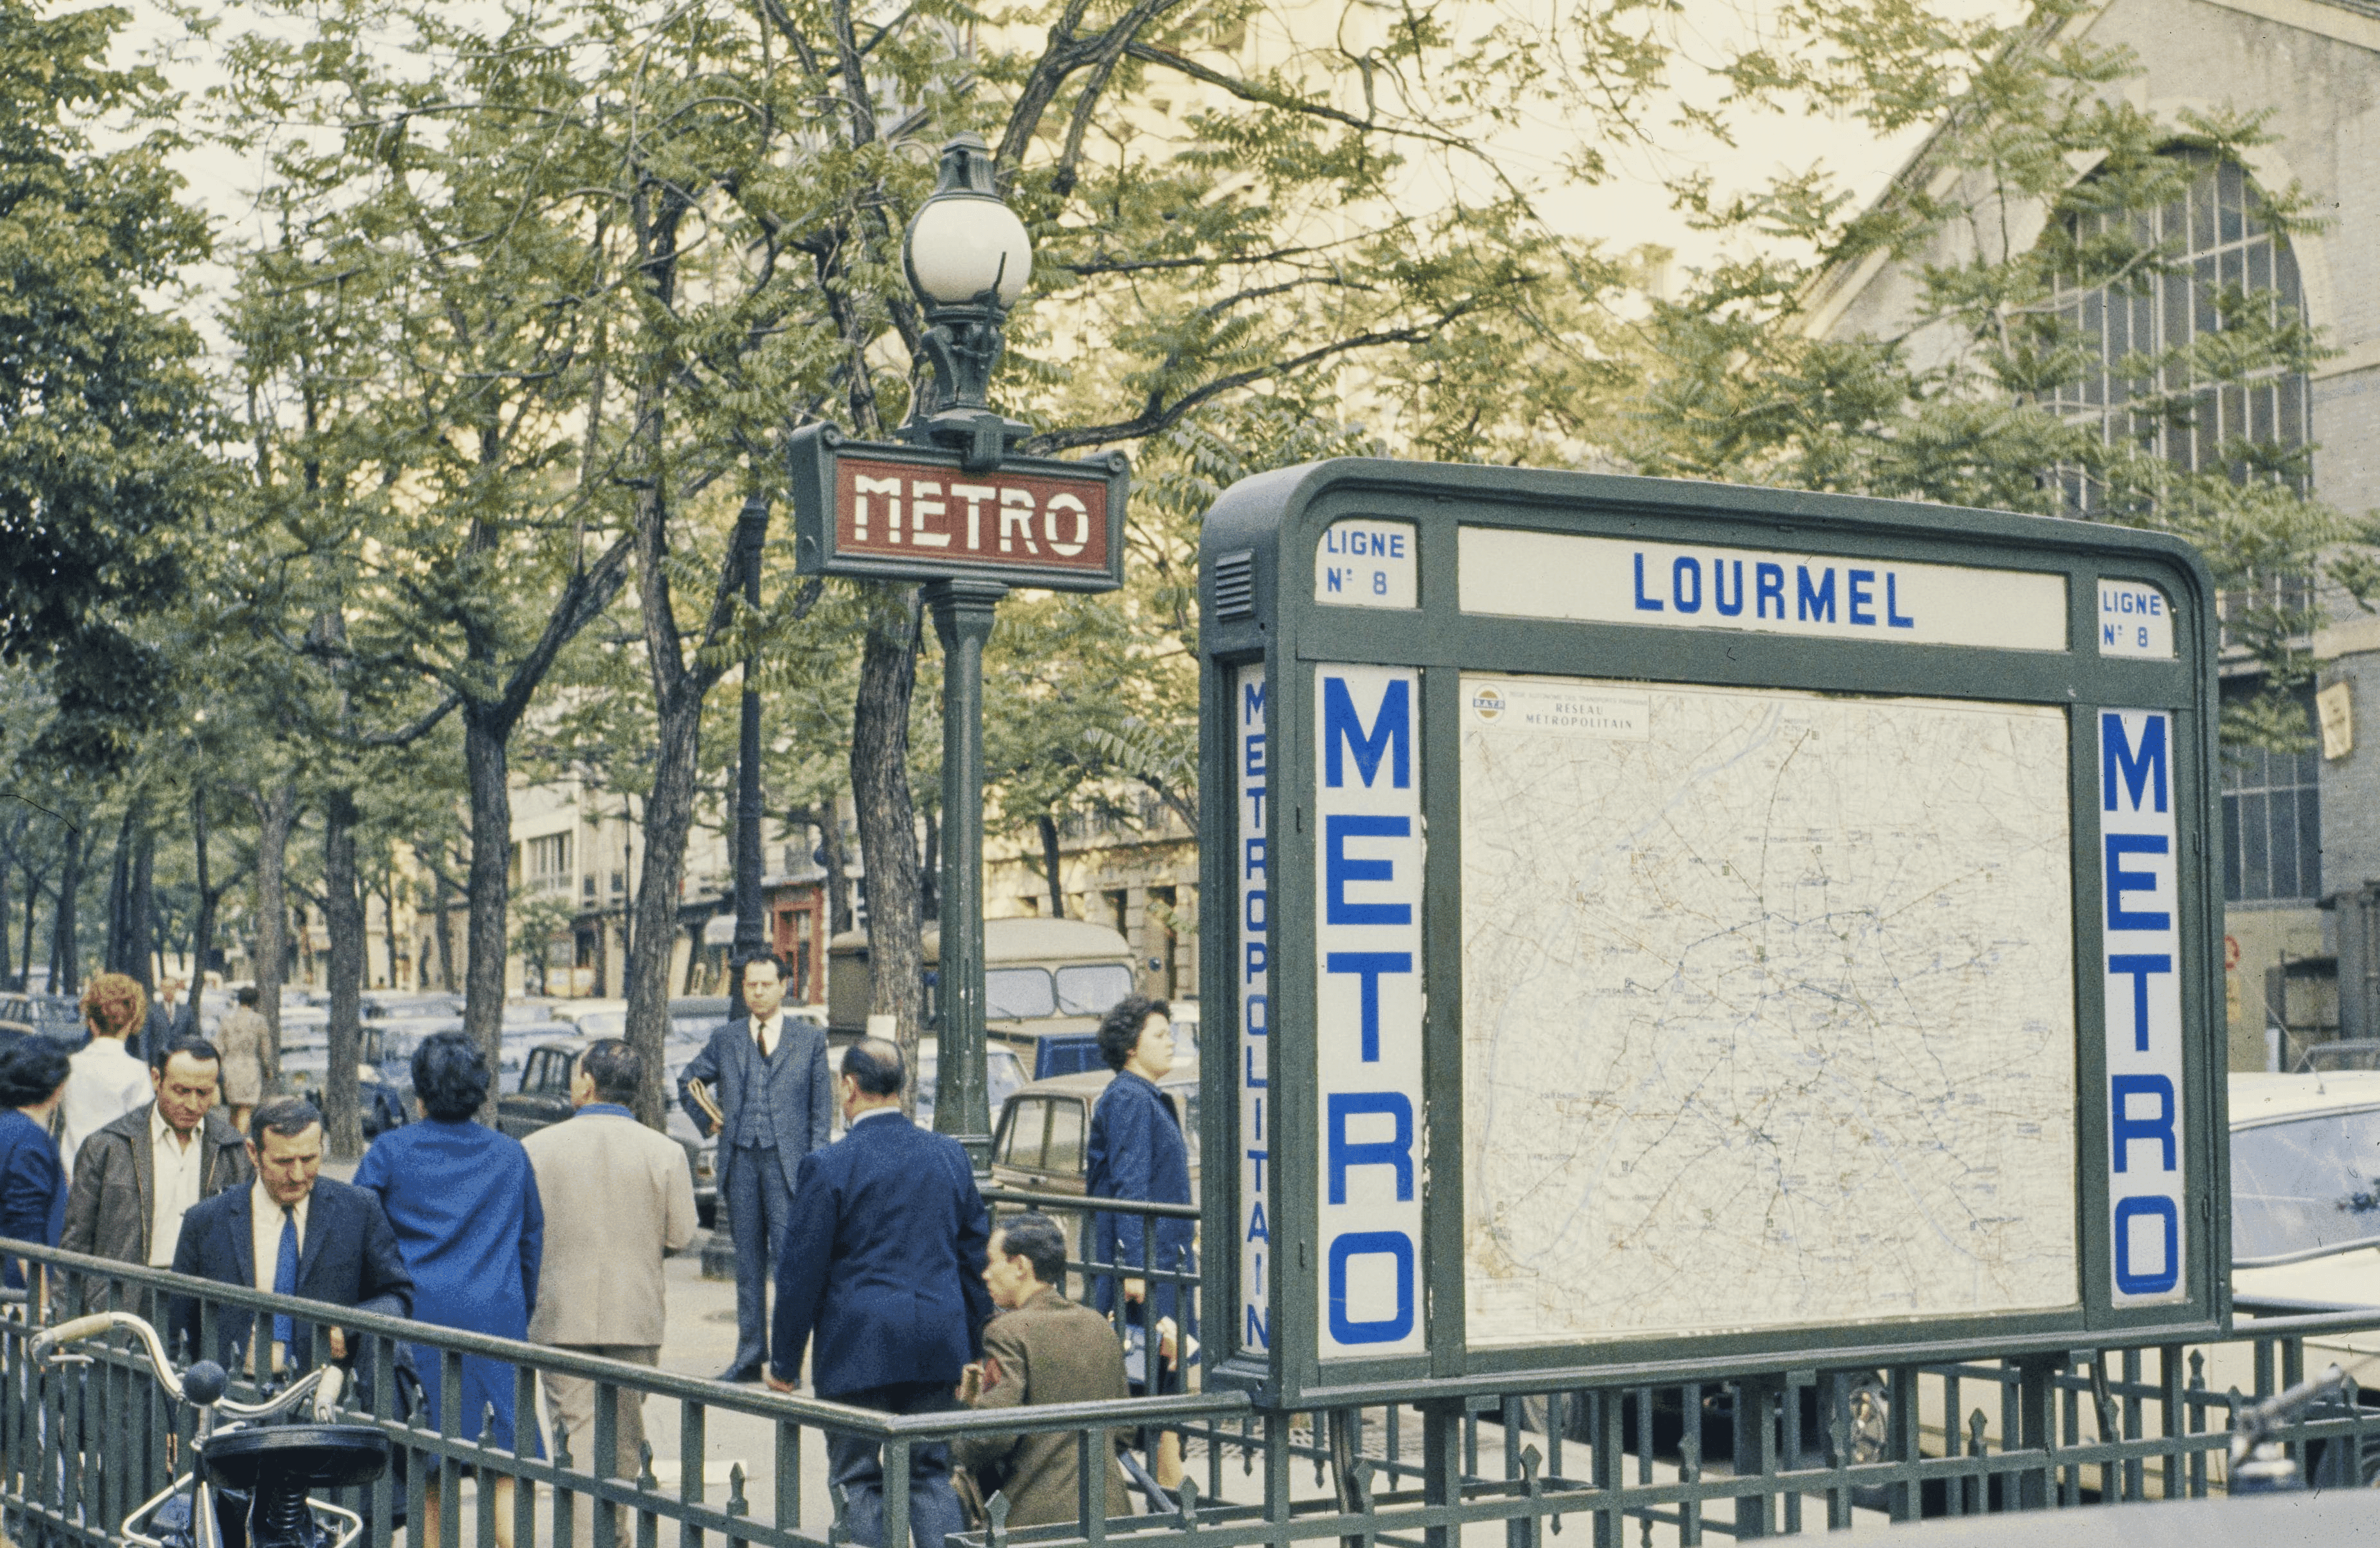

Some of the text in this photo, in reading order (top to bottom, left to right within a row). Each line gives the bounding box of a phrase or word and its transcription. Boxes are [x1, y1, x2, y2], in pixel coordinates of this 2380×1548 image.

[855, 475, 1089, 556] METRO
[1326, 529, 1405, 559] LIGNE
[1373, 571, 1387, 596] 8
[1634, 552, 1914, 628] LOURMEL
[2103, 590, 2161, 617] LIGNE
[2137, 626, 2148, 648] 8
[1245, 682, 1269, 1349] METROPOLITAIN
[1324, 677, 1414, 1345] METRO
[2101, 713, 2179, 1295] METRO
